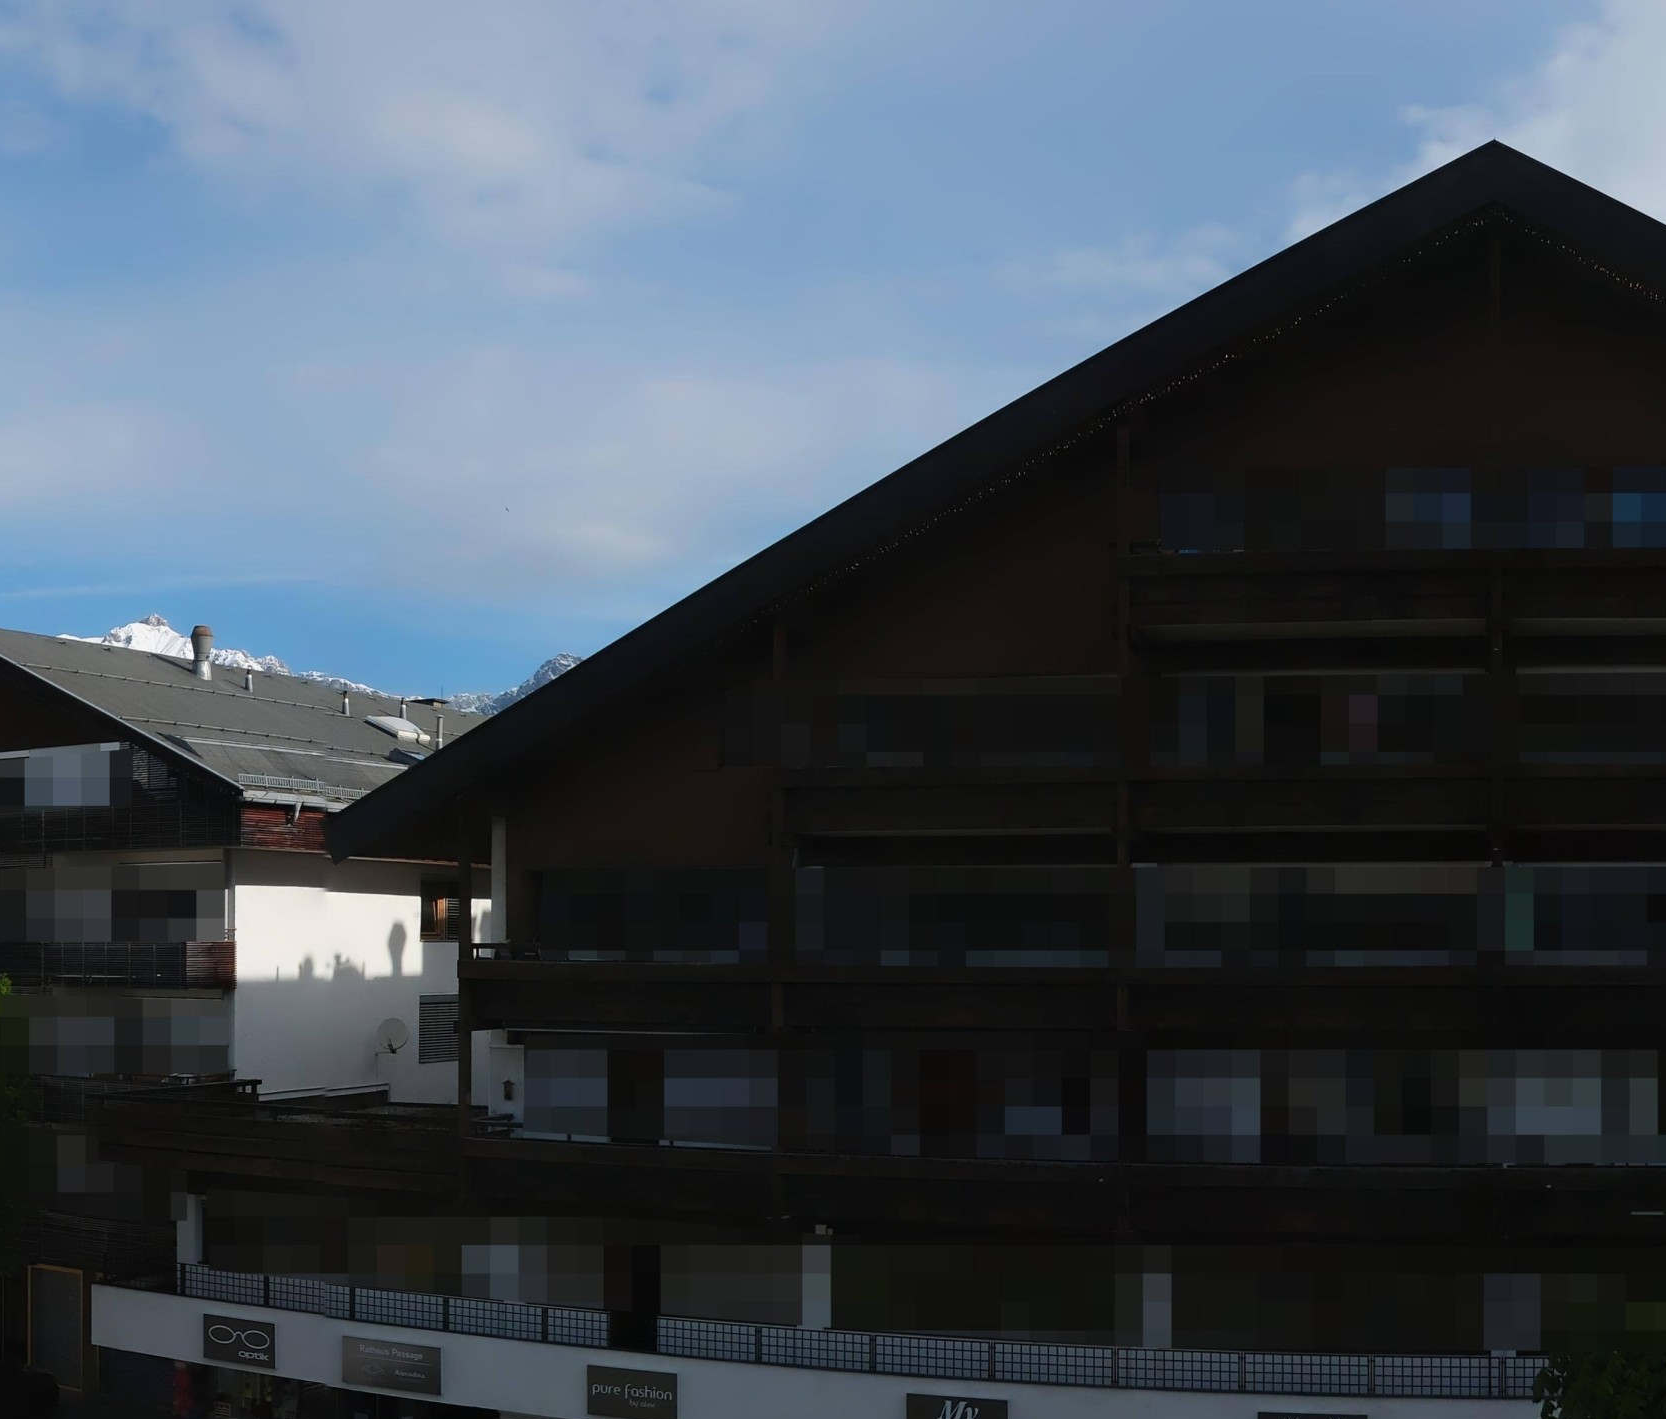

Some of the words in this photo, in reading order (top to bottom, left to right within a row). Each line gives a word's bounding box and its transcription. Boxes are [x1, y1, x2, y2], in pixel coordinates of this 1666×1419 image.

[238, 1350, 269, 1361] optik
[359, 1344, 390, 1356] Rathaus
[391, 1348, 424, 1361] Passage
[592, 1383, 621, 1396] pure
